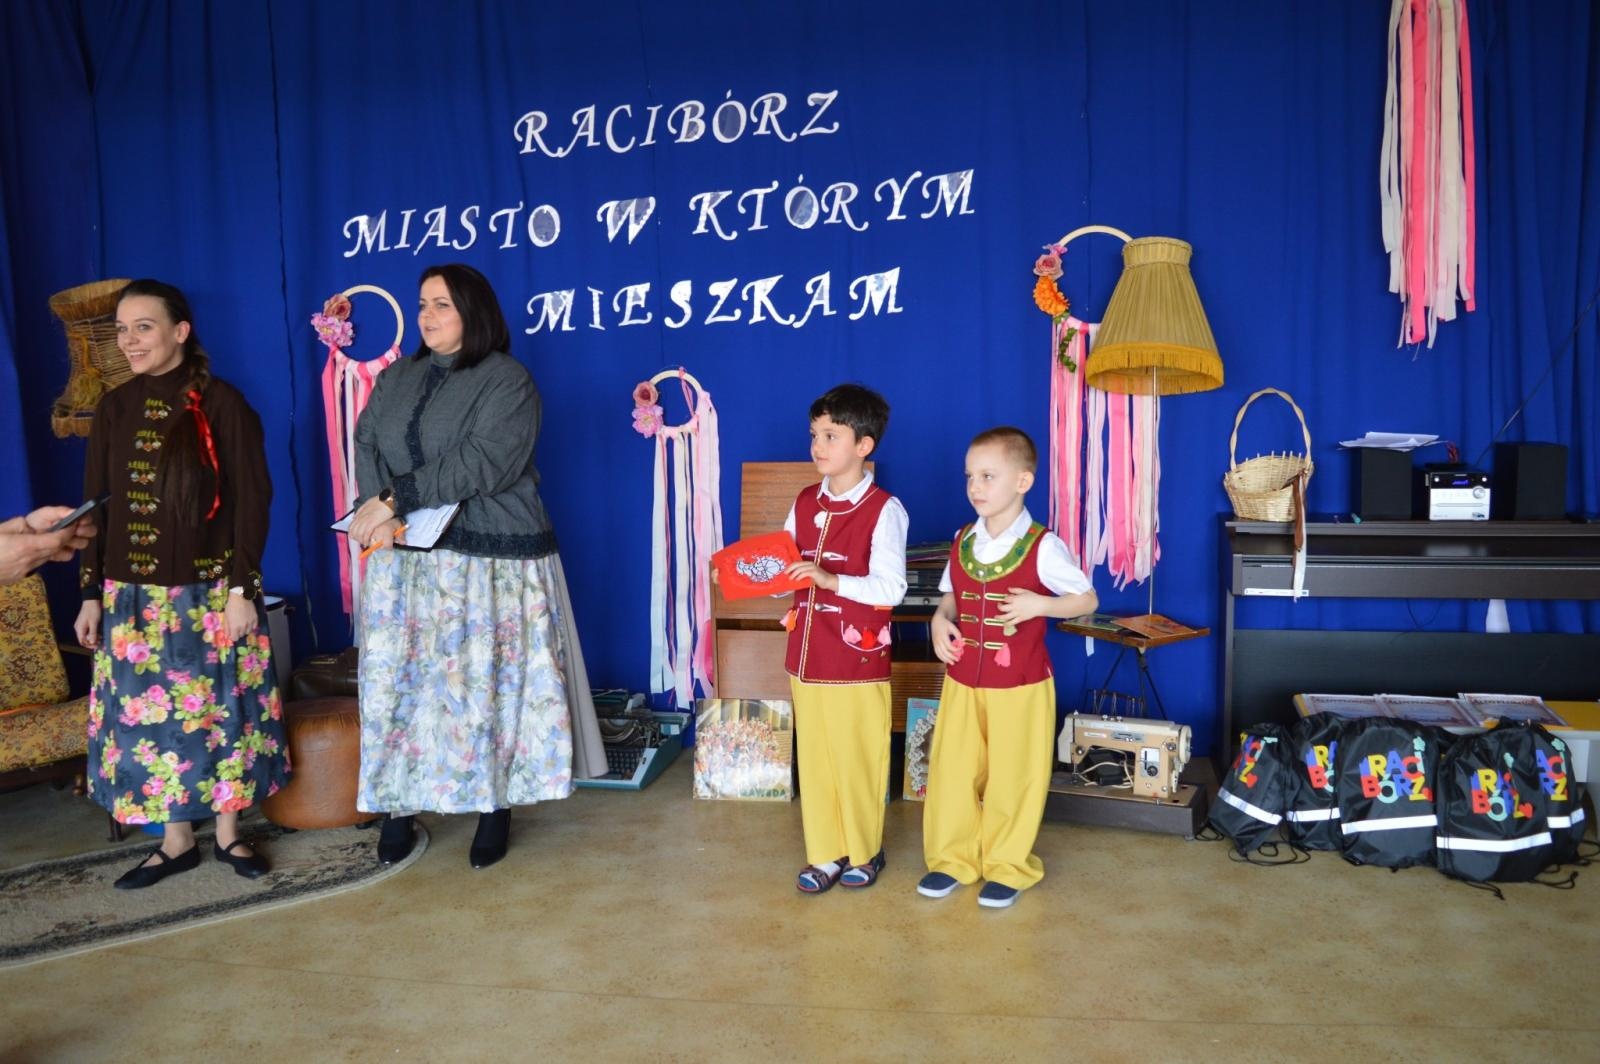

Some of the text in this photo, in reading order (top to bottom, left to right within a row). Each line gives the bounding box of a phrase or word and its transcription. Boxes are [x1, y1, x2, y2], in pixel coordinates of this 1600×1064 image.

[513, 89, 840, 158] RACIBÓRZ
[342, 168, 975, 258] MIASTO W KTÓRYM
[525, 266, 904, 335] MIESZKAM
